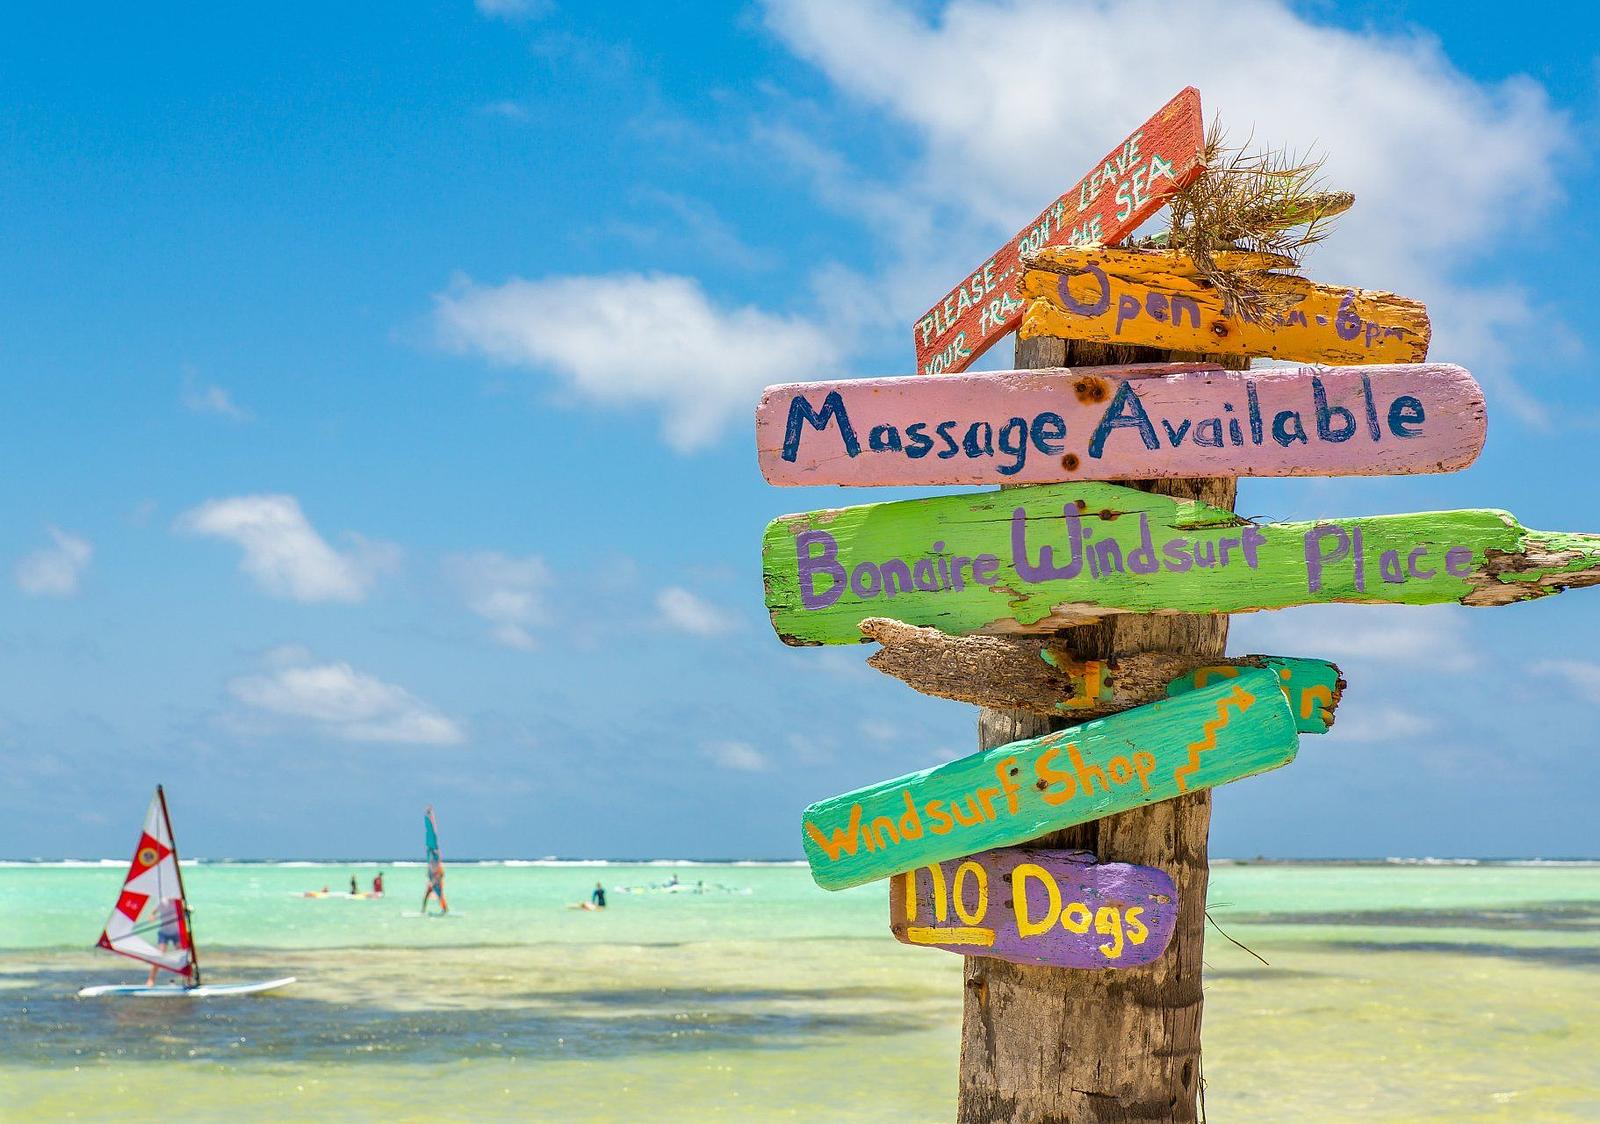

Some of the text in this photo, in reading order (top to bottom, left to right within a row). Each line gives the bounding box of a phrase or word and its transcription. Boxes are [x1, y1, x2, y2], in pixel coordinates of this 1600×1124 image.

[1077, 130, 1144, 213] LEAVE
[925, 330, 972, 375] YOUR
[978, 291, 1025, 336] TRA
[1114, 154, 1176, 222] SEA
[1058, 262, 1201, 335] Open
[780, 379, 1426, 475] Massage Available
[799, 500, 1475, 611] Bonaire Windsurf Place
[805, 744, 1156, 861] Windsurf Shop
[1011, 863, 1149, 959] Dogs
